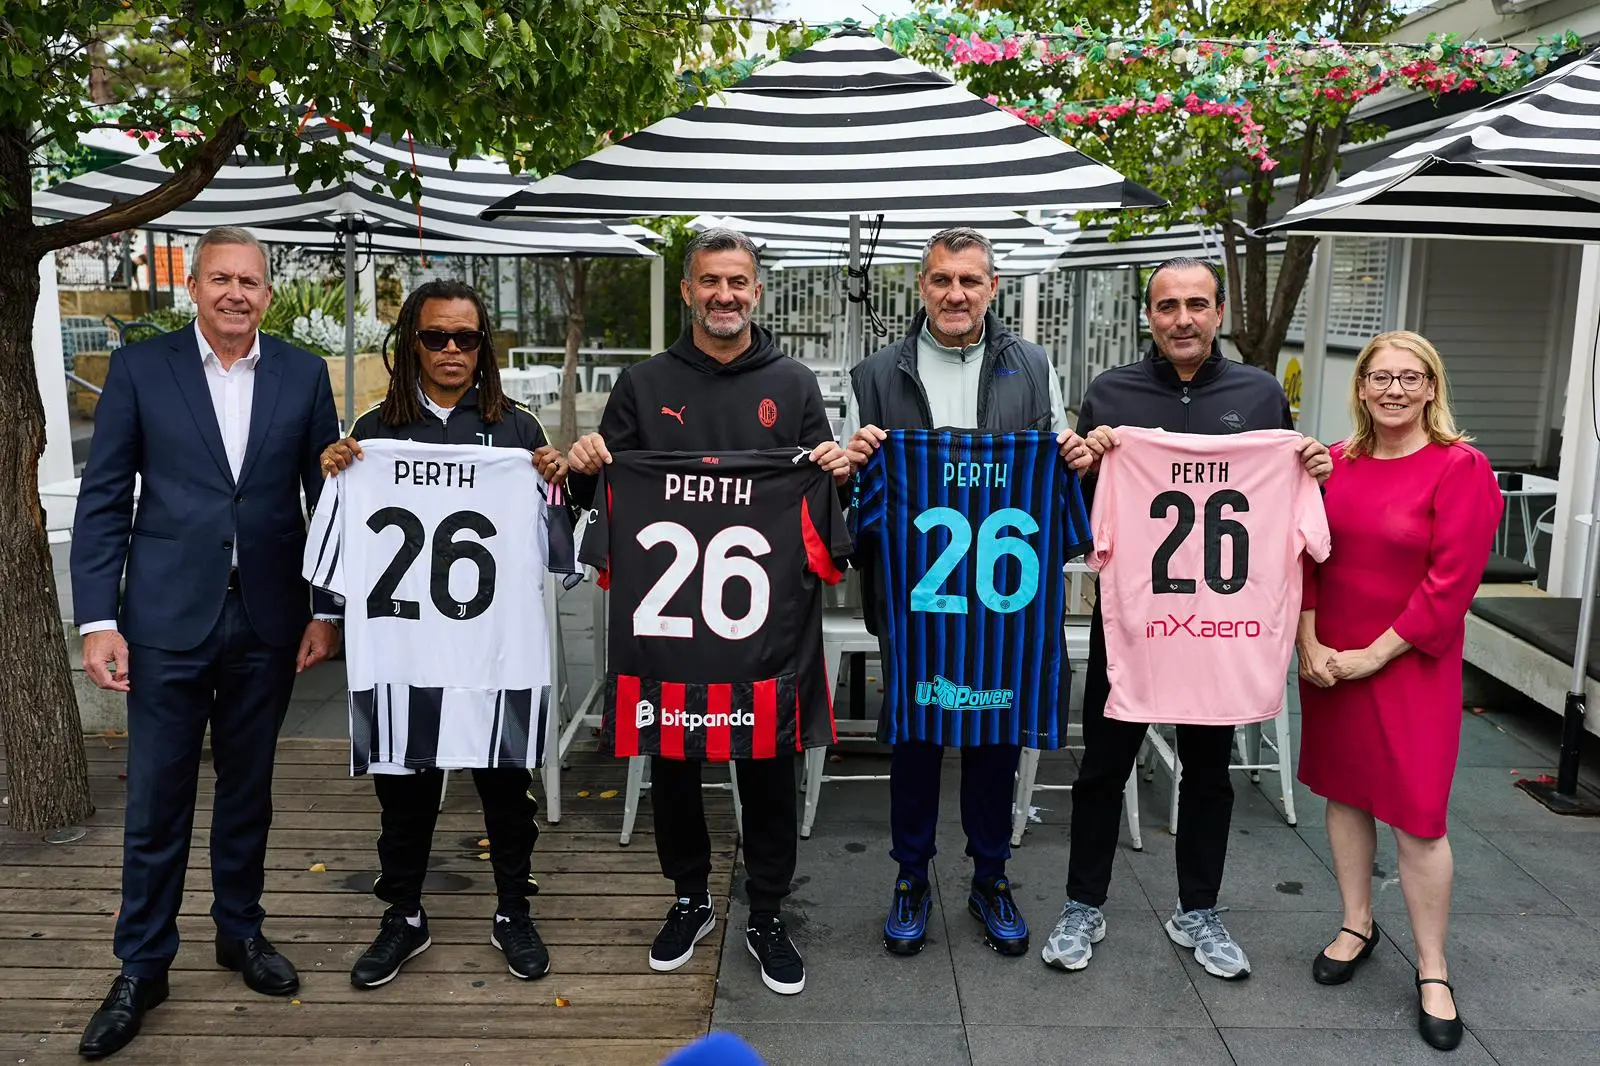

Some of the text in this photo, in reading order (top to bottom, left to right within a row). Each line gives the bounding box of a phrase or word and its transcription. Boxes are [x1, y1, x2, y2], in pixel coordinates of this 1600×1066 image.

[394, 460, 476, 488] PERTH
[943, 462, 1008, 488] PERTH
[1171, 461, 1229, 484] PERTH
[664, 473, 753, 506] PERTH
[1149, 489, 1250, 595] 26
[366, 506, 497, 620] 26
[910, 506, 1040, 615] 26
[633, 521, 772, 640] 26
[1146, 614, 1261, 638] inX.aero
[661, 708, 755, 732] bitpanda
